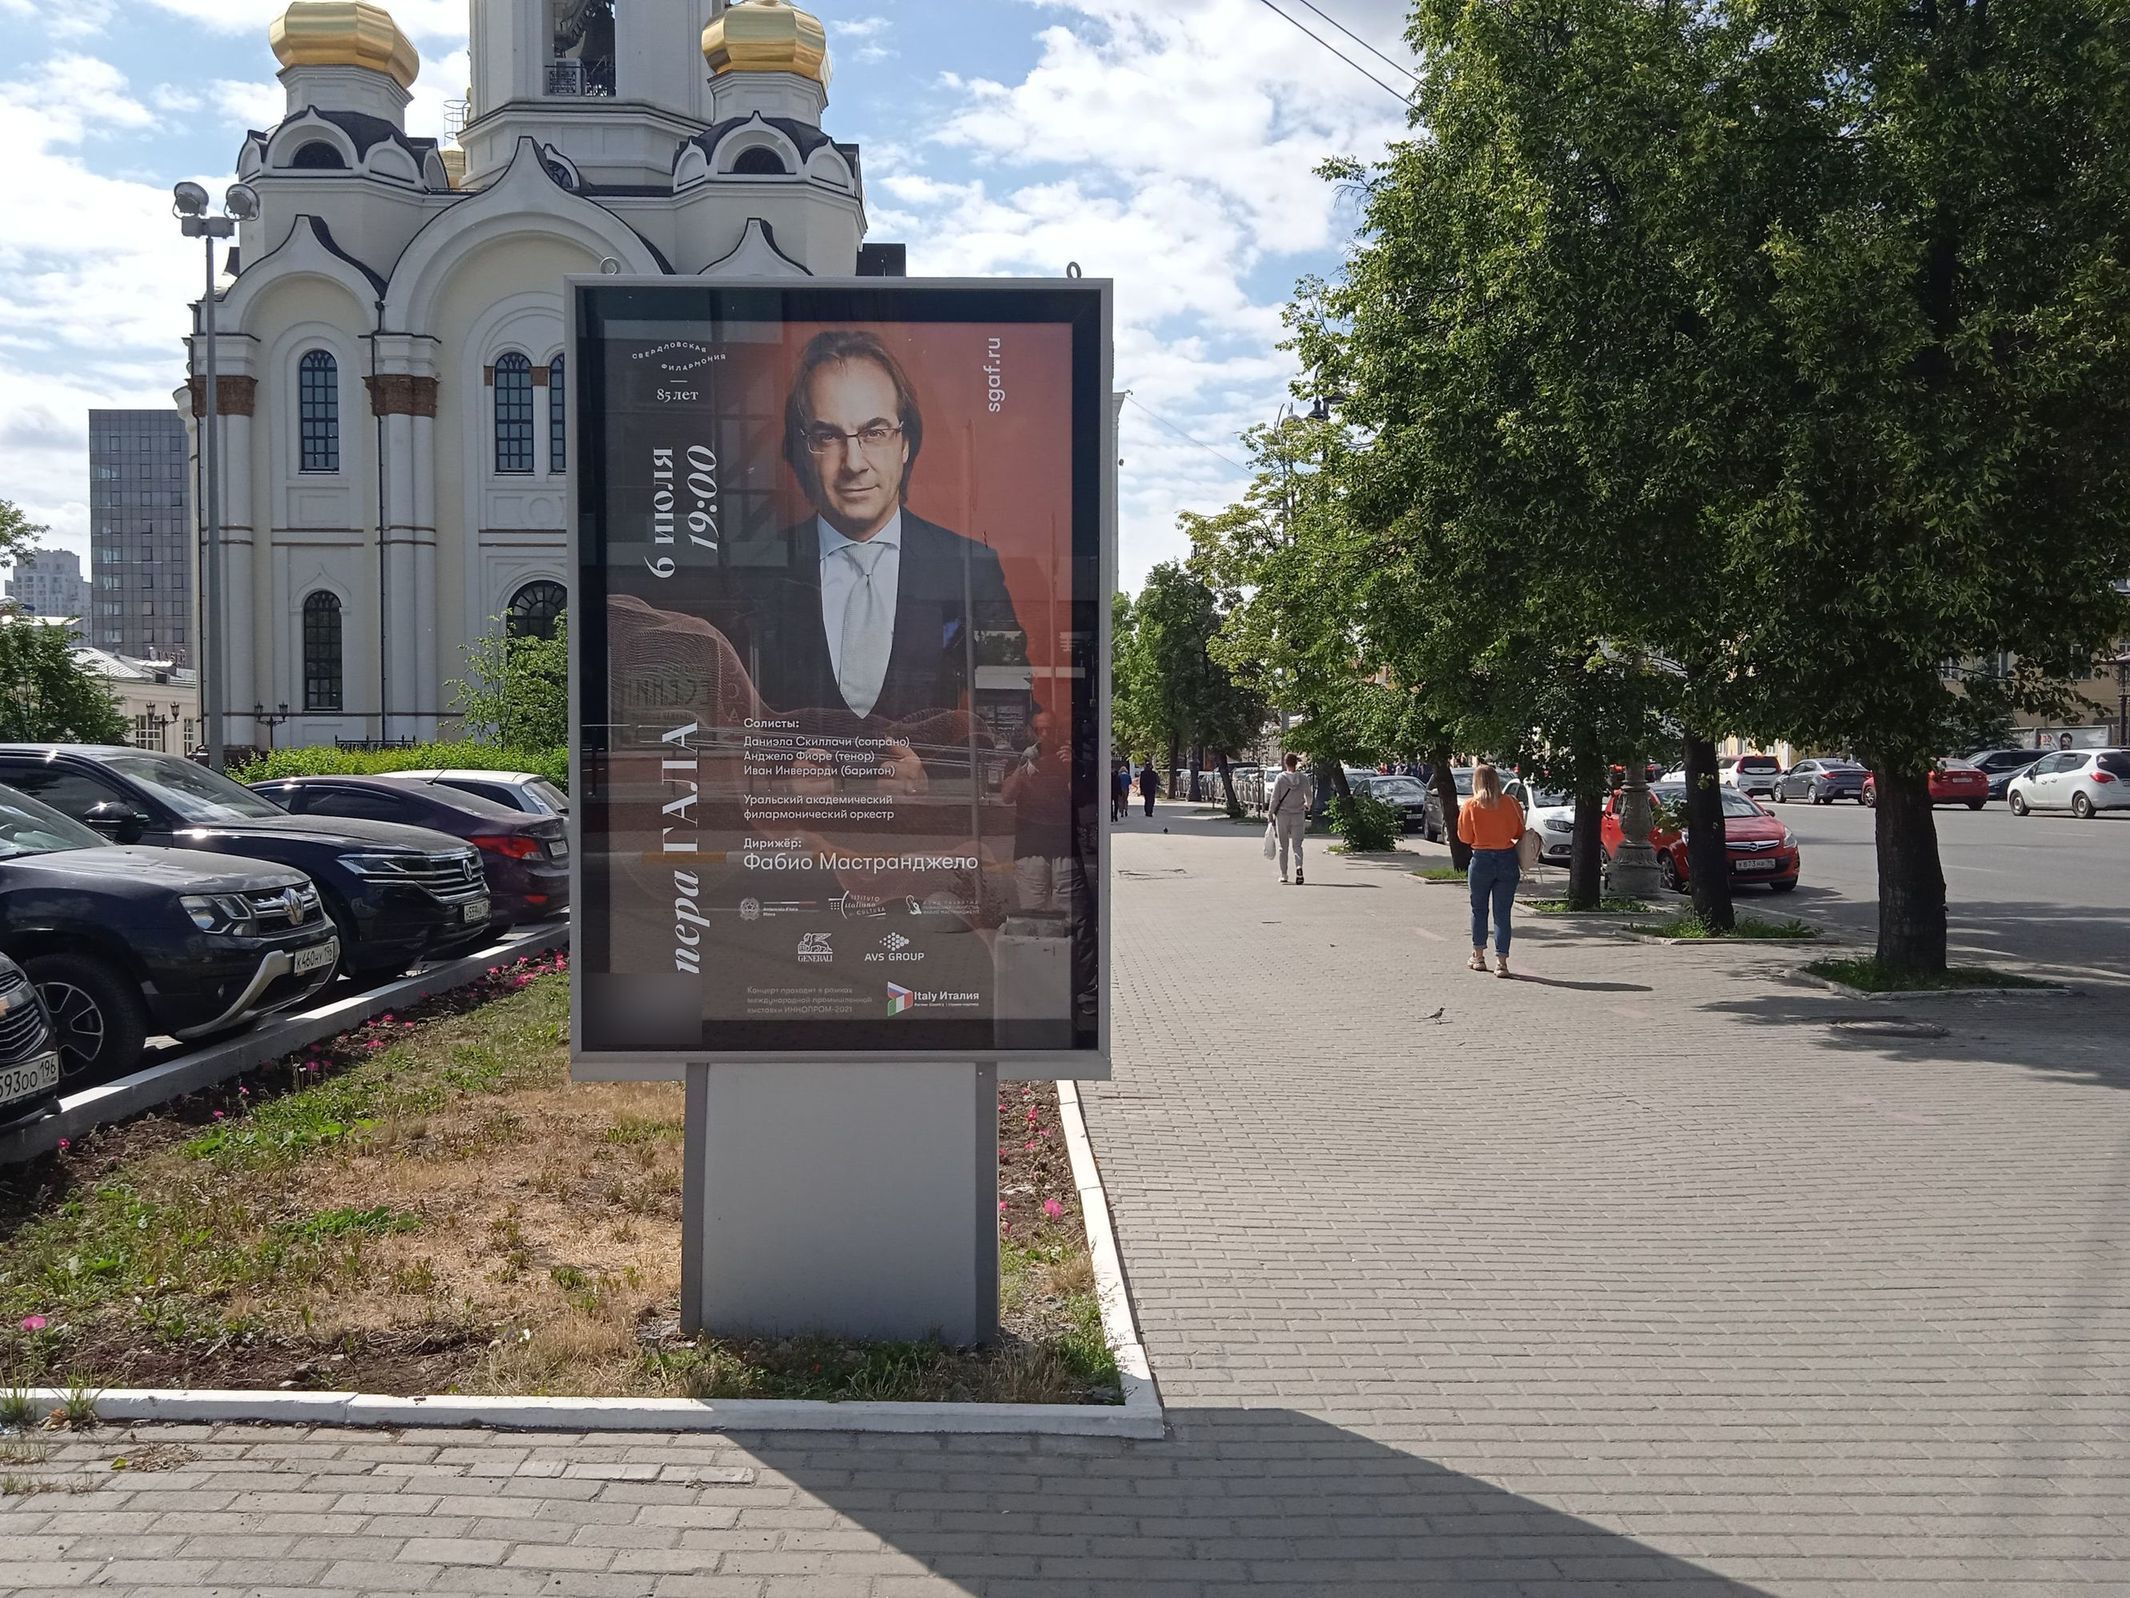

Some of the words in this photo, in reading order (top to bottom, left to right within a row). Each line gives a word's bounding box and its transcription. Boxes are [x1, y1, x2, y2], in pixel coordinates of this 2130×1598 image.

[632, 341, 707, 359] СВЕРДЛОВСКАЯ
[661, 353, 726, 371] ФИЛАРМОНИЯ
[983, 337, 1006, 413] sgaf.ru
[656, 388, 671, 403] 85
[672, 391, 699, 401] лет
[653, 447, 675, 545] июля
[686, 444, 720, 553] 19:00
[643, 555, 676, 579] 6
[743, 718, 800, 729] Солисты:
[743, 736, 793, 748] Даниэла
[796, 736, 852, 747] Скиллачи
[855, 736, 910, 749] (сопрано)
[743, 751, 794, 762] Анджело
[796, 751, 833, 763] Фиоре
[835, 751, 875, 763] (тенор)
[743, 765, 773, 776] Иван
[775, 765, 838, 777] Инверарди
[841, 765, 896, 778] (баритон)
[661, 719, 698, 856] ГАЛА
[743, 794, 804, 806] Уральский
[806, 795, 893, 806] академический
[743, 809, 848, 822] филармонический
[850, 811, 895, 822] оркестр
[743, 838, 803, 850] Дирижёр:
[743, 852, 814, 871] Фабио
[819, 853, 979, 875] Мастранджело
[674, 870, 711, 976] пера
[797, 954, 833, 963] GENERALI
[864, 953, 885, 962] AVS
[888, 953, 925, 962] GROUP
[914, 991, 937, 1002] Italy
[939, 991, 980, 1001] Италия
[40, 1058, 56, 1077] 196
